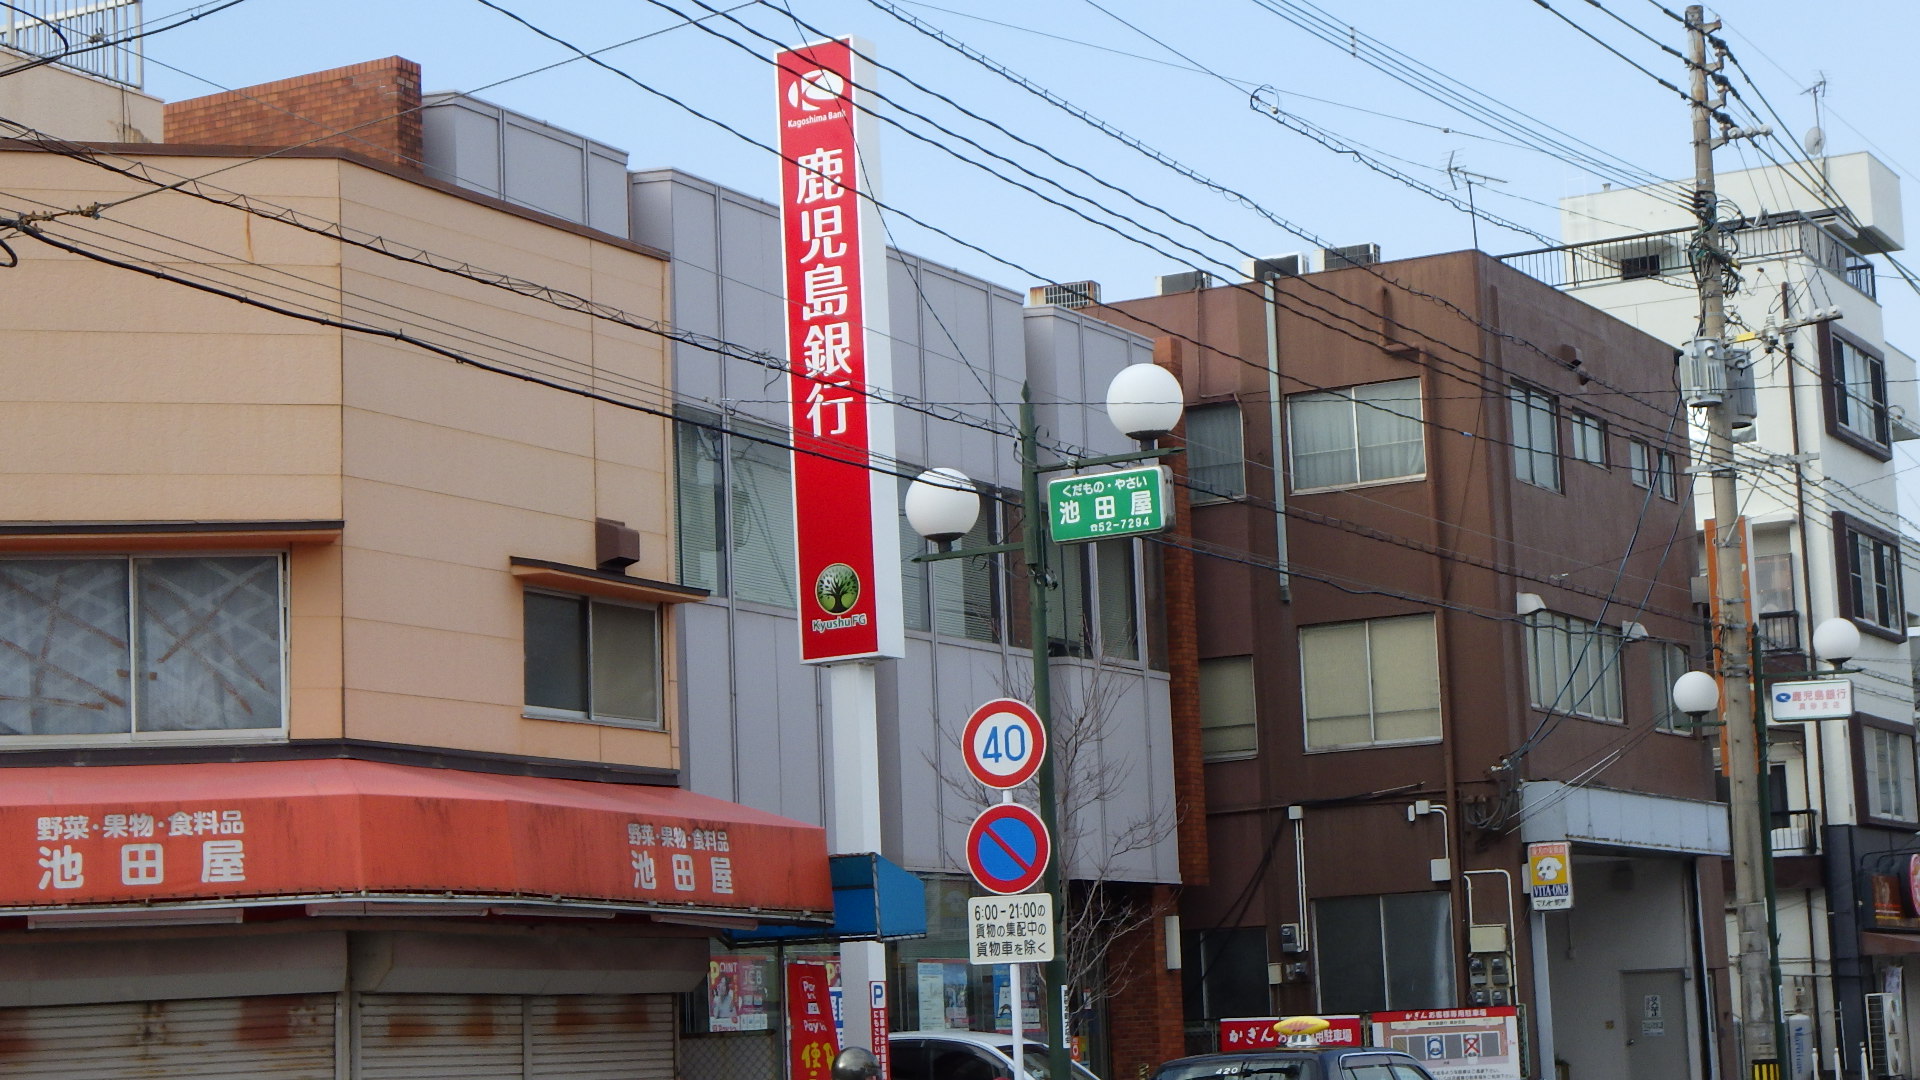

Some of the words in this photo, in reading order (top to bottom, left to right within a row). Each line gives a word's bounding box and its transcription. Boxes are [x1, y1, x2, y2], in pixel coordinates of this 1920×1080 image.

[787, 114, 826, 129] Kagoshima
[828, 109, 846, 120] Bank
[796, 147, 854, 438] 鹿児島銀行
[1062, 476, 1148, 497] くだもの・やさい
[1060, 490, 1153, 525] 池田屋
[1792, 688, 1846, 702] 鹿児島銀行
[982, 724, 1026, 763] 40
[37, 809, 245, 842] 野菜・果物・食料品
[627, 823, 730, 853] 野菜・果物・食料品
[38, 839, 246, 891] 池田屋
[631, 850, 734, 895] 池田屋
[975, 921, 1047, 939] 貨物の集配中の
[976, 939, 1047, 958] 貨物車を除く
[873, 985, 883, 1005] P
[1215, 1067, 1239, 1075] 420
